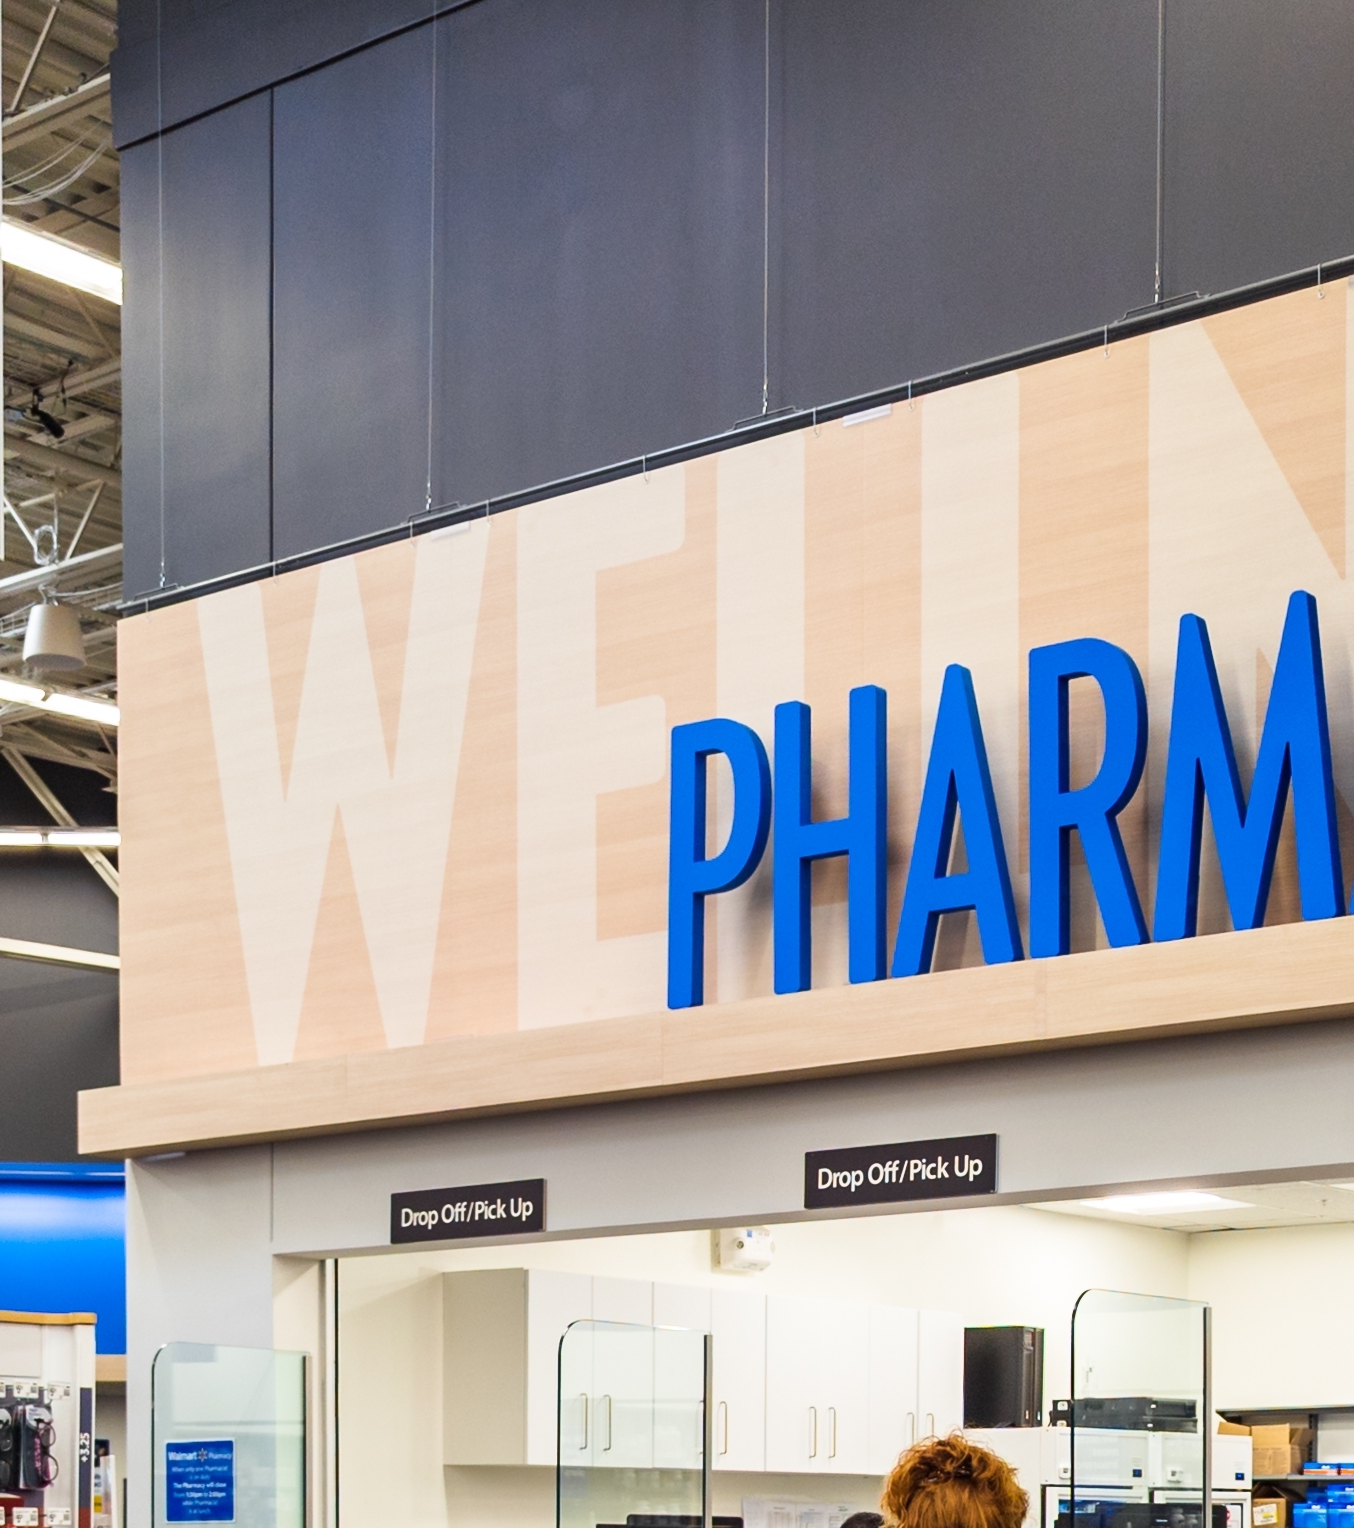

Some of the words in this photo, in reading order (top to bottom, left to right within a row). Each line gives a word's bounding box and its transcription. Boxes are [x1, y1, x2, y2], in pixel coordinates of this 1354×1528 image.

[817, 1164, 864, 1191] Drop
[867, 1159, 950, 1187] Off/Pick
[954, 1156, 983, 1182] Up
[401, 1205, 438, 1228] Drop
[441, 1200, 506, 1223] Off/Pick
[510, 1198, 533, 1220] Up
[79, 1431, 91, 1463] +3.25
